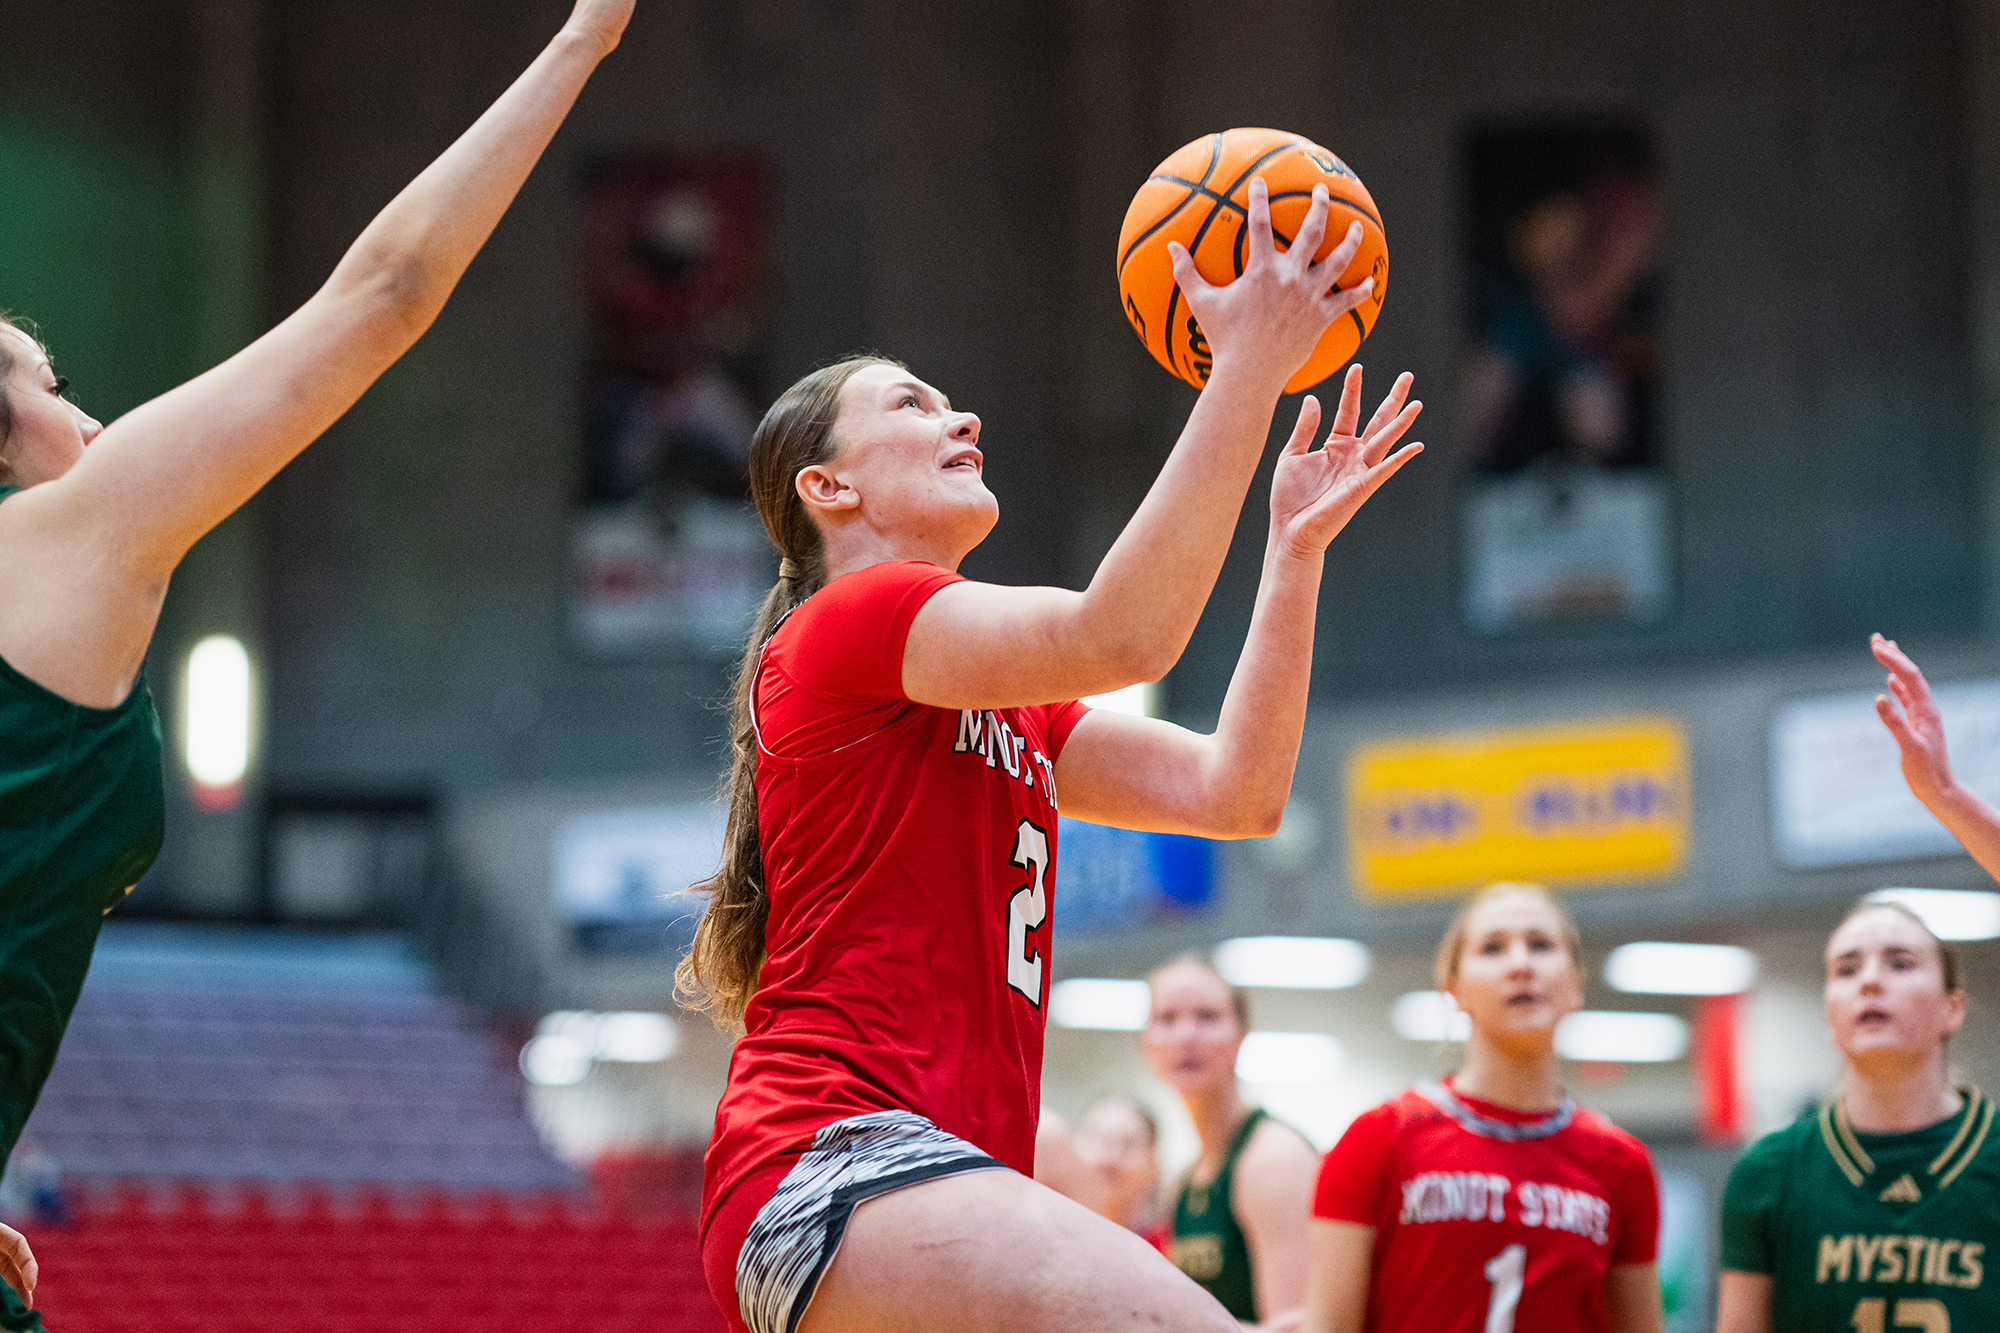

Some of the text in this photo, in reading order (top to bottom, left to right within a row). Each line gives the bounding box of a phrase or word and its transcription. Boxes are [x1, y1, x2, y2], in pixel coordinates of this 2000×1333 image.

[1006, 815, 1050, 1010] 2
[1483, 1242, 1527, 1333] 1
[1815, 1233, 1985, 1289] MYSTICS
